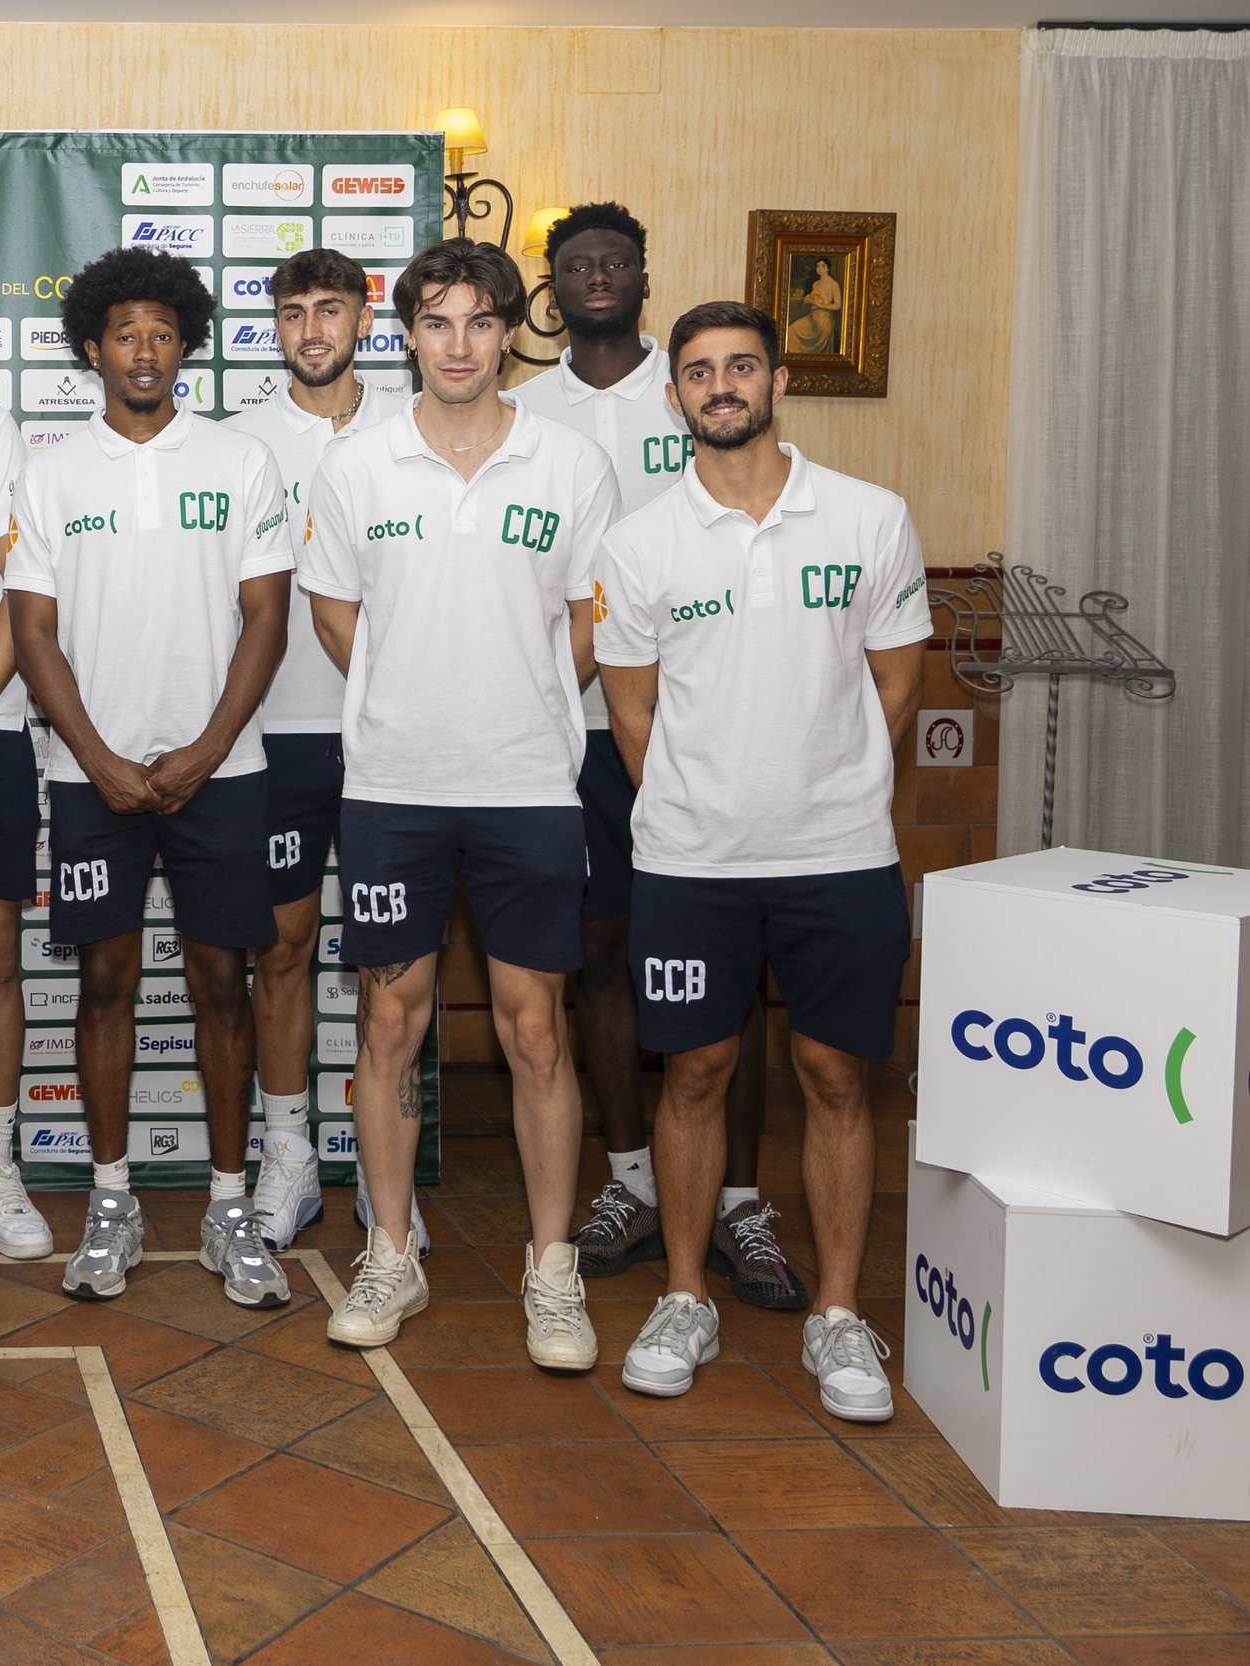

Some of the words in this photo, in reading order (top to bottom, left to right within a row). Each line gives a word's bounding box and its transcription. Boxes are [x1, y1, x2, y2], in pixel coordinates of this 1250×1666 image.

[155, 229, 204, 242] PACC
[331, 231, 375, 241] CLÍNICA
[2, 284, 29, 295] DEL
[179, 491, 230, 534] CCB
[501, 503, 561, 553] CCB
[801, 564, 862, 612] CCB
[267, 830, 301, 869] CB
[60, 859, 110, 902] CCB
[1072, 870, 1190, 894] coto
[352, 882, 408, 926] CCB
[155, 940, 178, 955] RG3
[645, 957, 706, 1005] CCB
[951, 1009, 1144, 1090] coto
[153, 1134, 175, 1149] RG3
[915, 1253, 975, 1350] coto
[1039, 1334, 1245, 1401] coto
